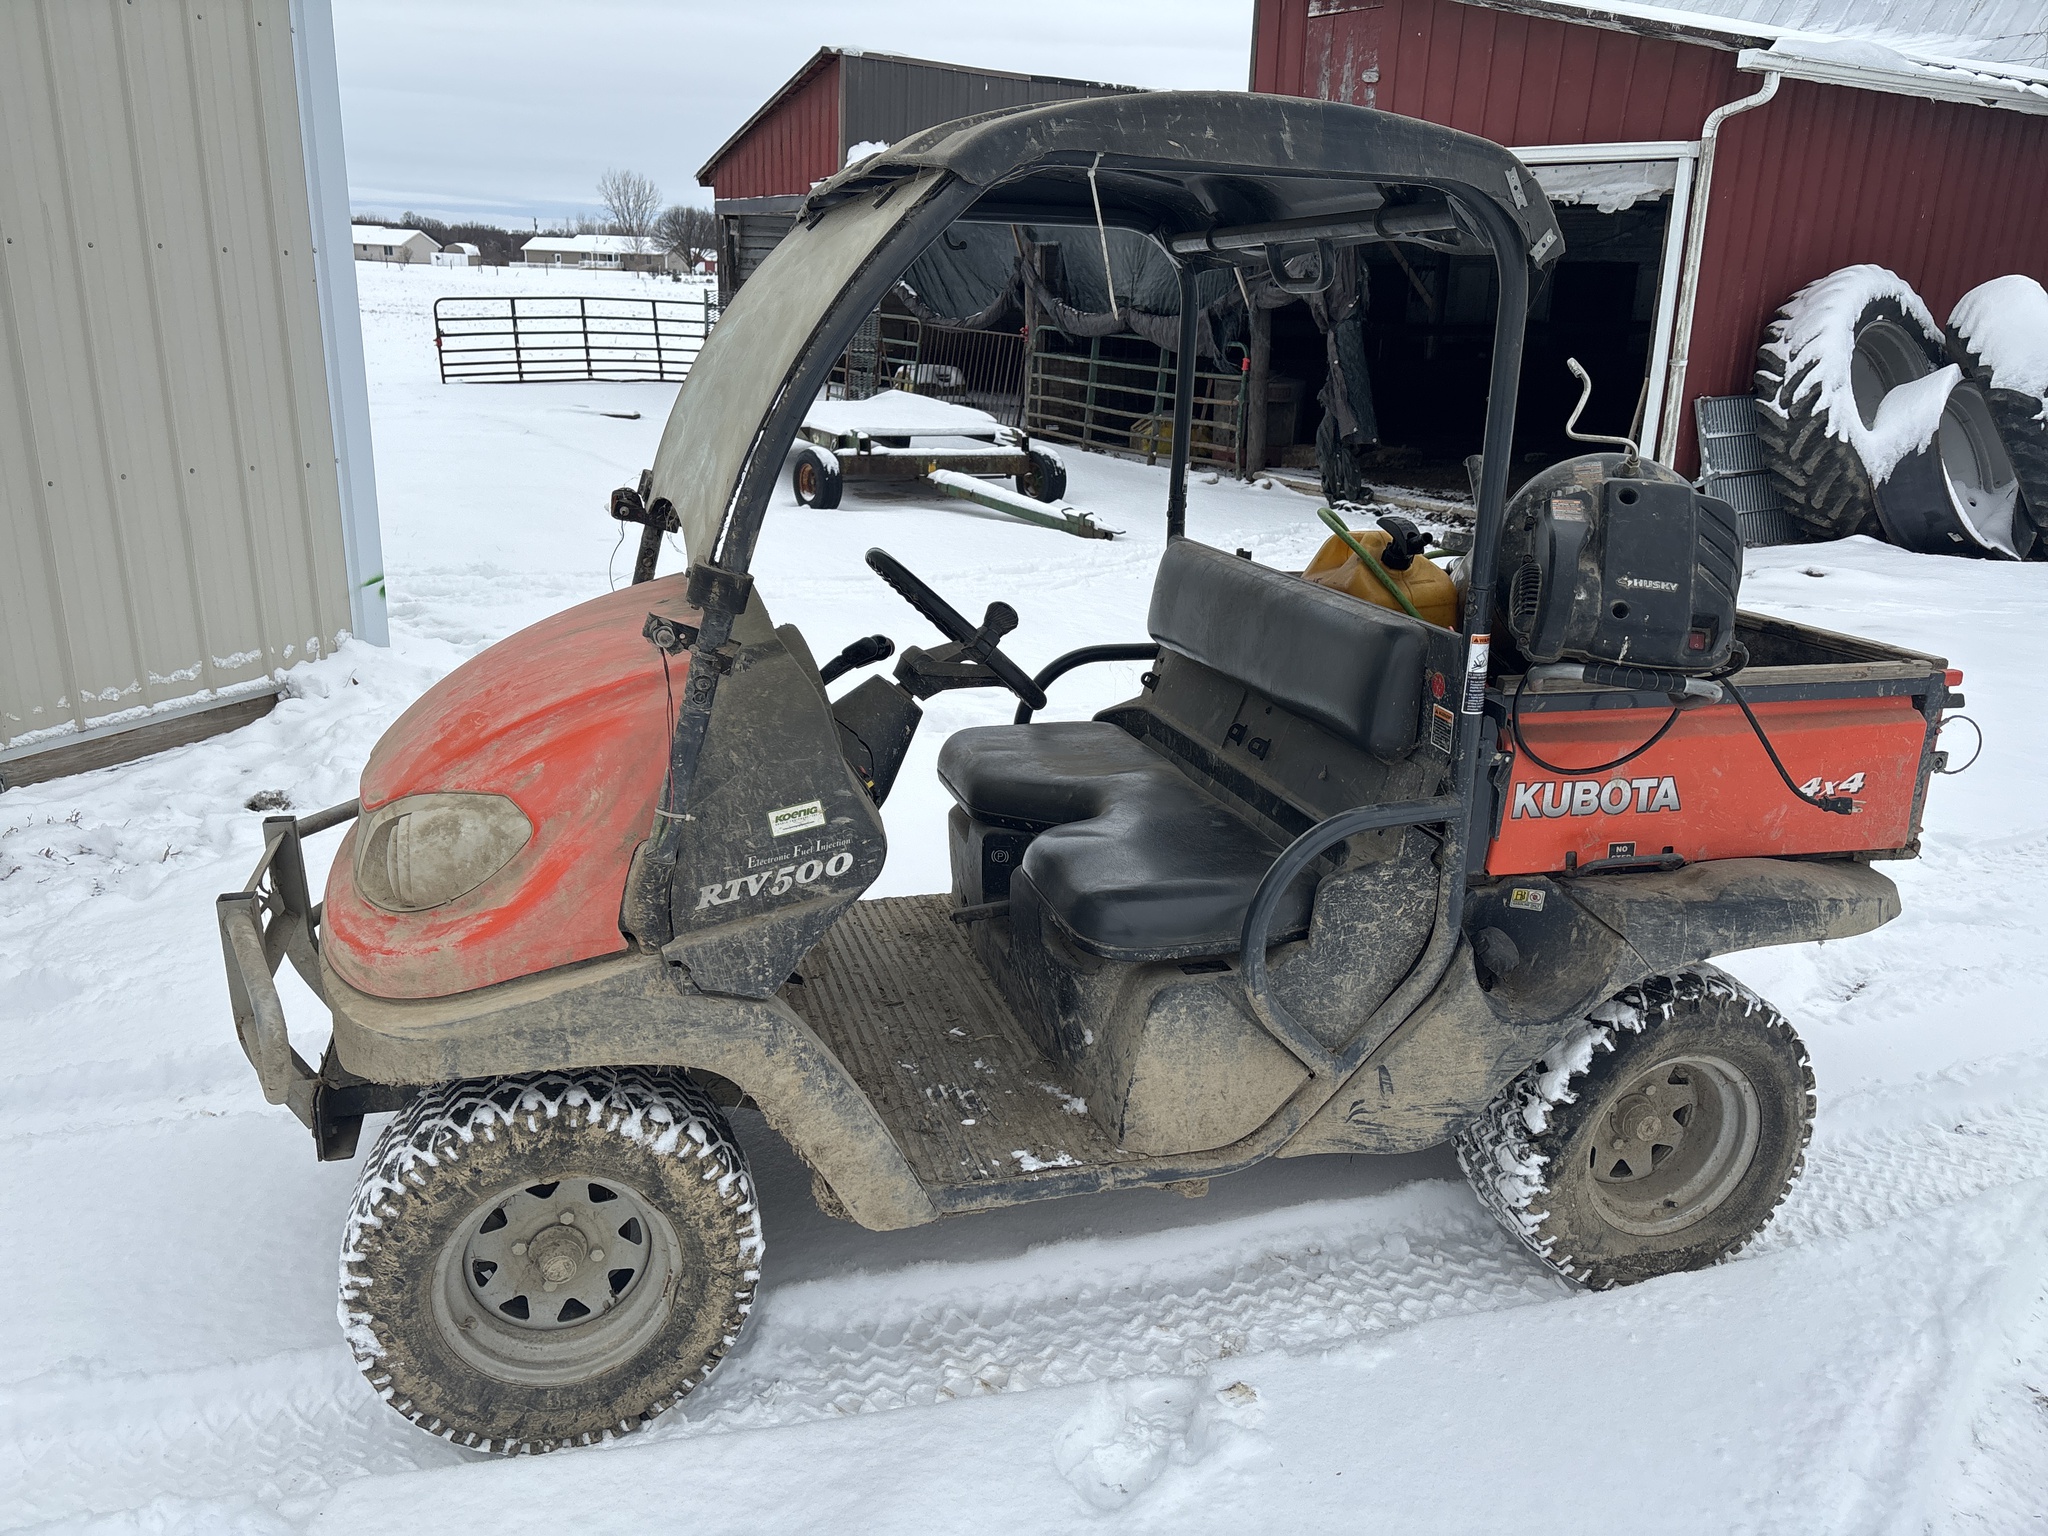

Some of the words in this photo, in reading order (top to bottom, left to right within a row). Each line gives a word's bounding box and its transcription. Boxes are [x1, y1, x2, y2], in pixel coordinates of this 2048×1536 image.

[1633, 578, 1679, 591] HUSKY
[1511, 776, 1681, 819] KUBOTA
[1799, 772, 1865, 797] 4x4
[747, 855, 791, 869] Electronic
[792, 844, 813, 858] Fuel
[815, 839, 851, 853] Injection
[1616, 845, 1628, 853] NO
[695, 852, 854, 910] RTV500
